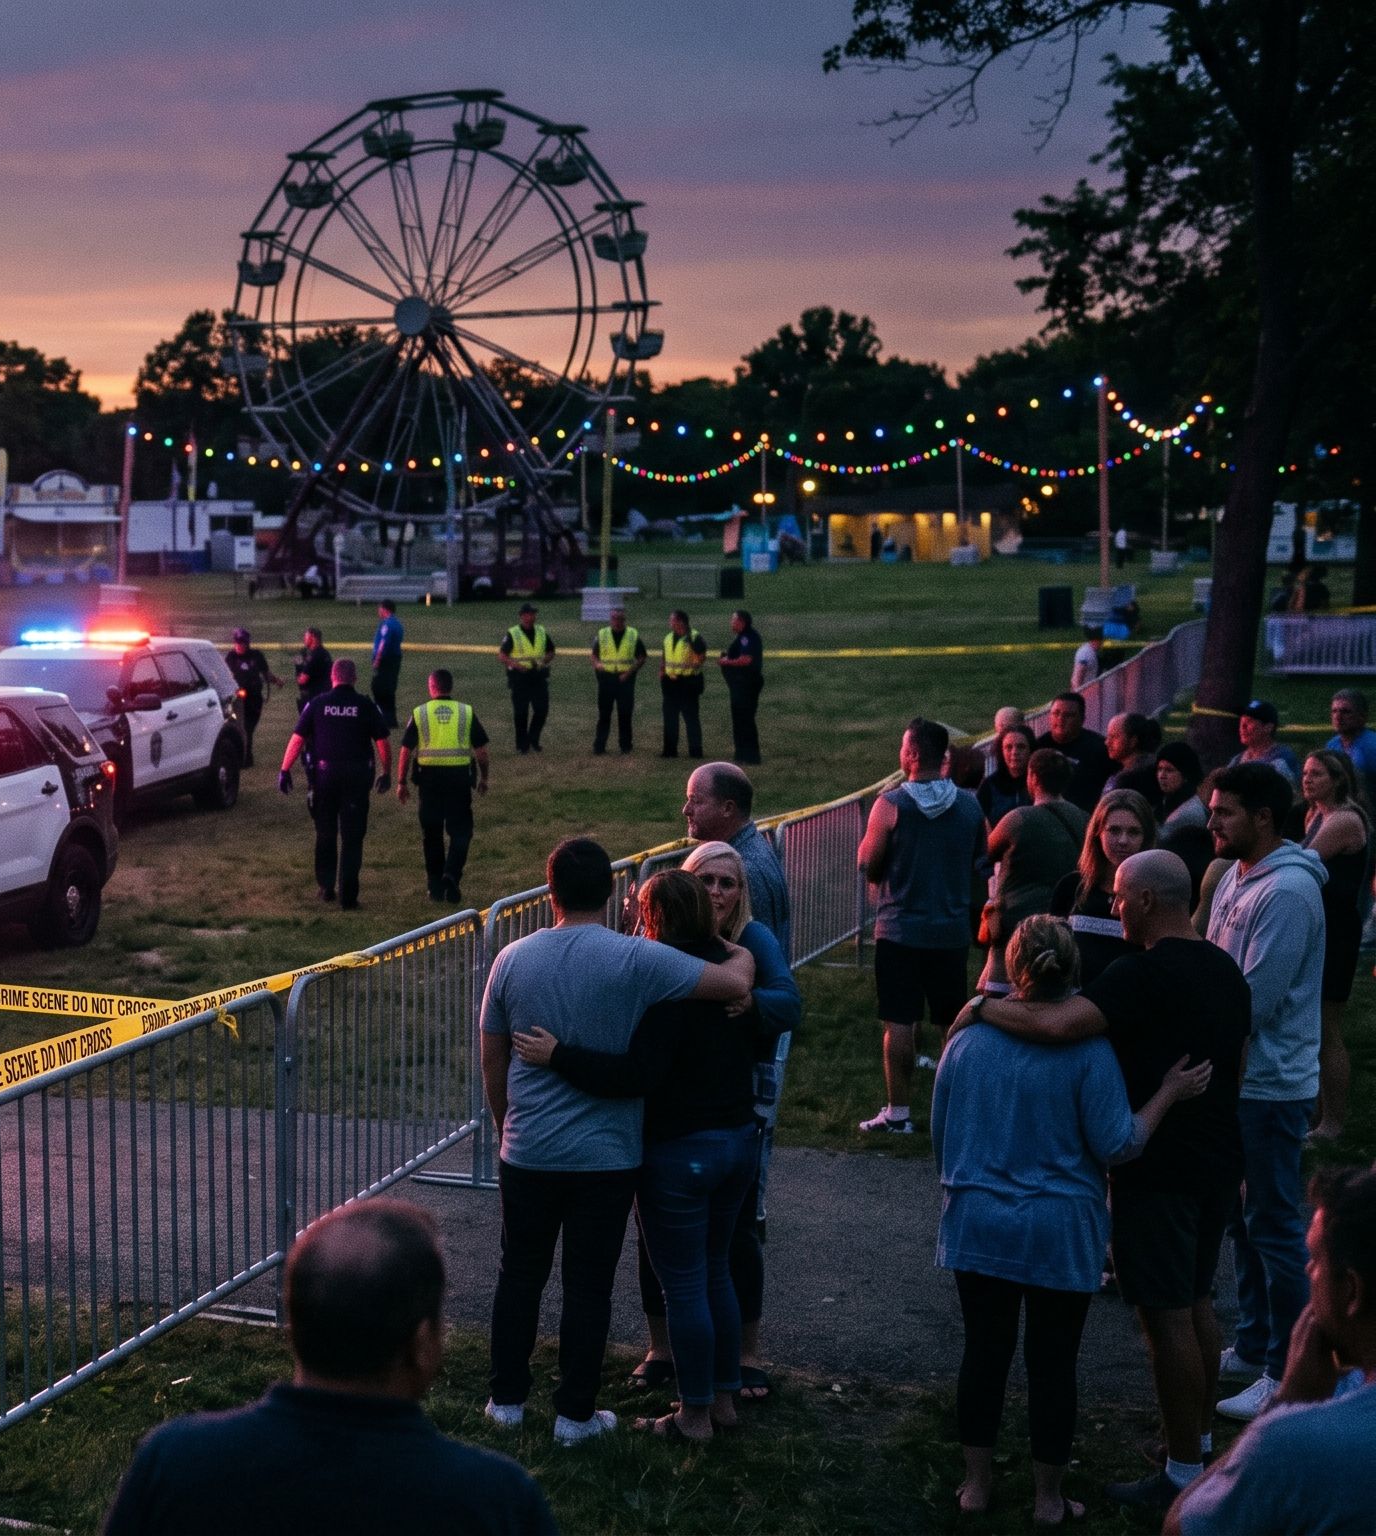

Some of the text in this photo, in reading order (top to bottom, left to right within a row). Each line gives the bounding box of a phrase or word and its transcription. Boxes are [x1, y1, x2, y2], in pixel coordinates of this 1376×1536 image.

[324, 705, 358, 717] POLICE
[32, 992, 68, 1010] SCENE
[73, 995, 88, 1012] DO
[92, 997, 114, 1014] NOT
[4, 1050, 39, 1084] SCENE
[40, 1045, 56, 1071] DO
[57, 1038, 76, 1066] NOT
[80, 1027, 112, 1058] CROSS
